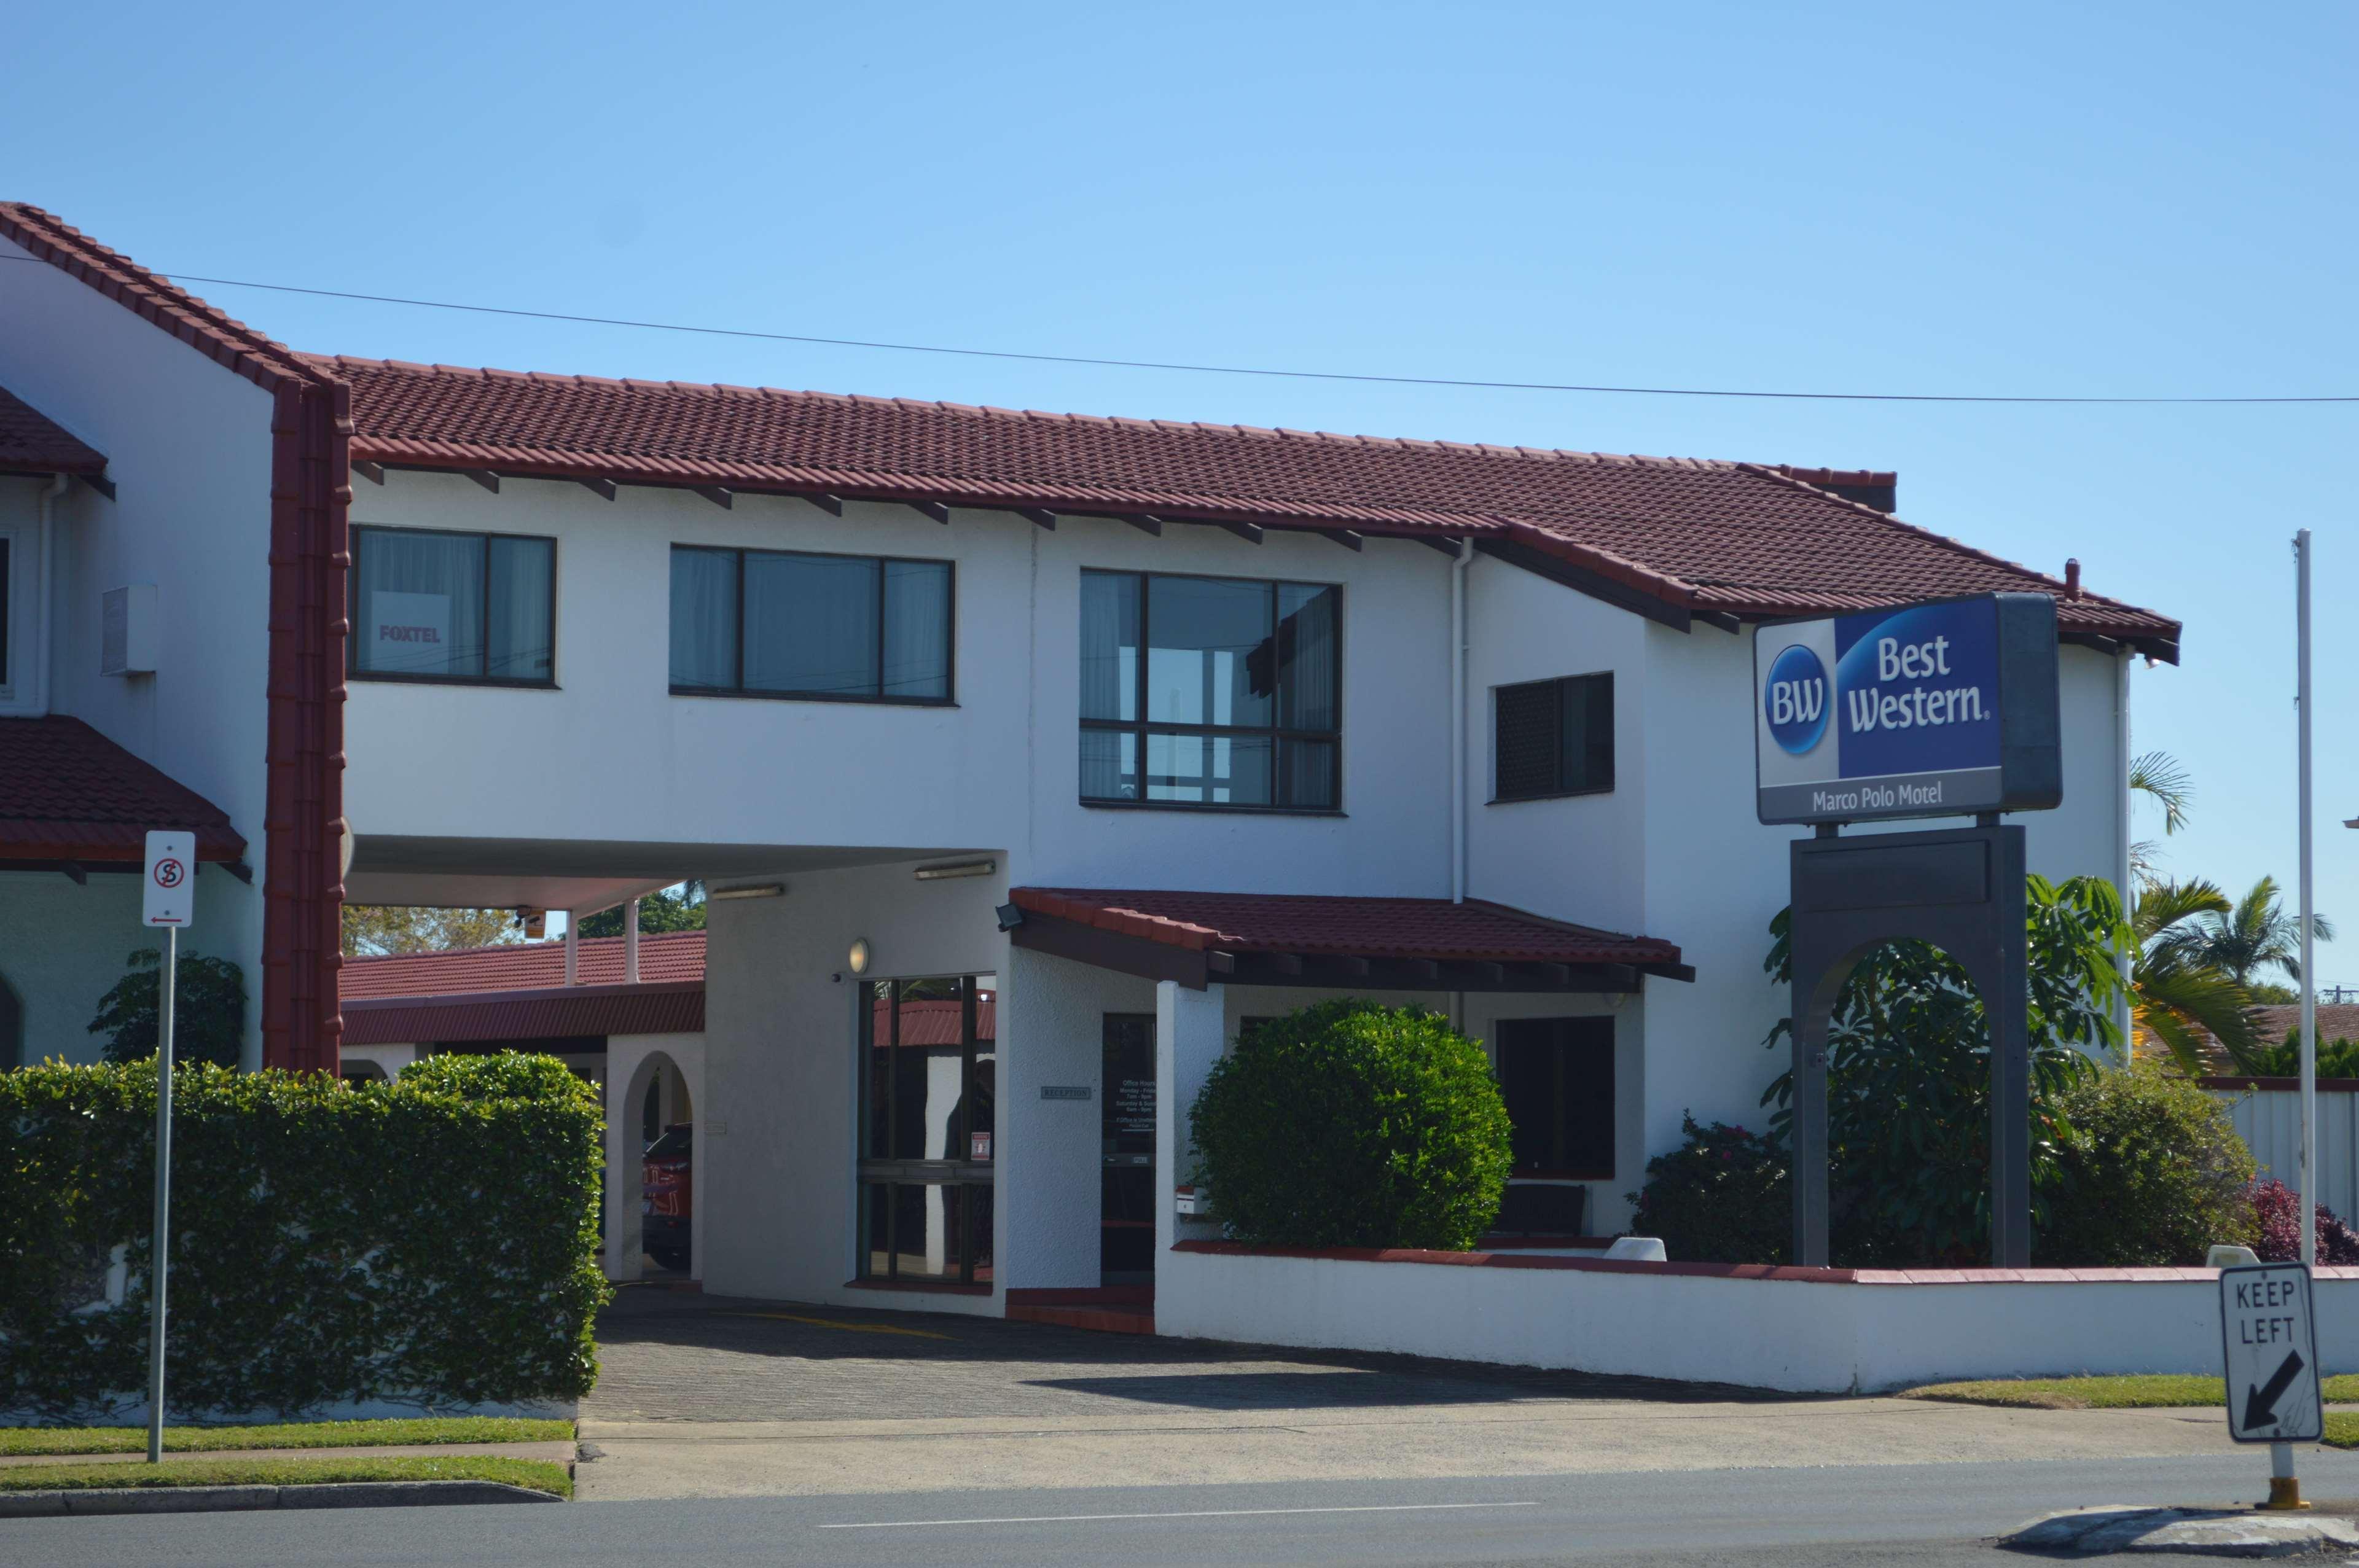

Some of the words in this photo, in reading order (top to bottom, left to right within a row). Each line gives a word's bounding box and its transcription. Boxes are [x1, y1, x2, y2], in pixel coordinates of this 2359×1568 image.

[379, 625, 440, 643] FOXTEL
[1878, 635, 1951, 682] Best
[1772, 677, 1823, 725] BW
[1813, 790, 1858, 811] Marco
[1862, 786, 1895, 809] Polo
[1898, 781, 1942, 806] Motel
[2237, 1281, 2295, 1309] KEEP
[2241, 1317, 2295, 1344] LEFT
